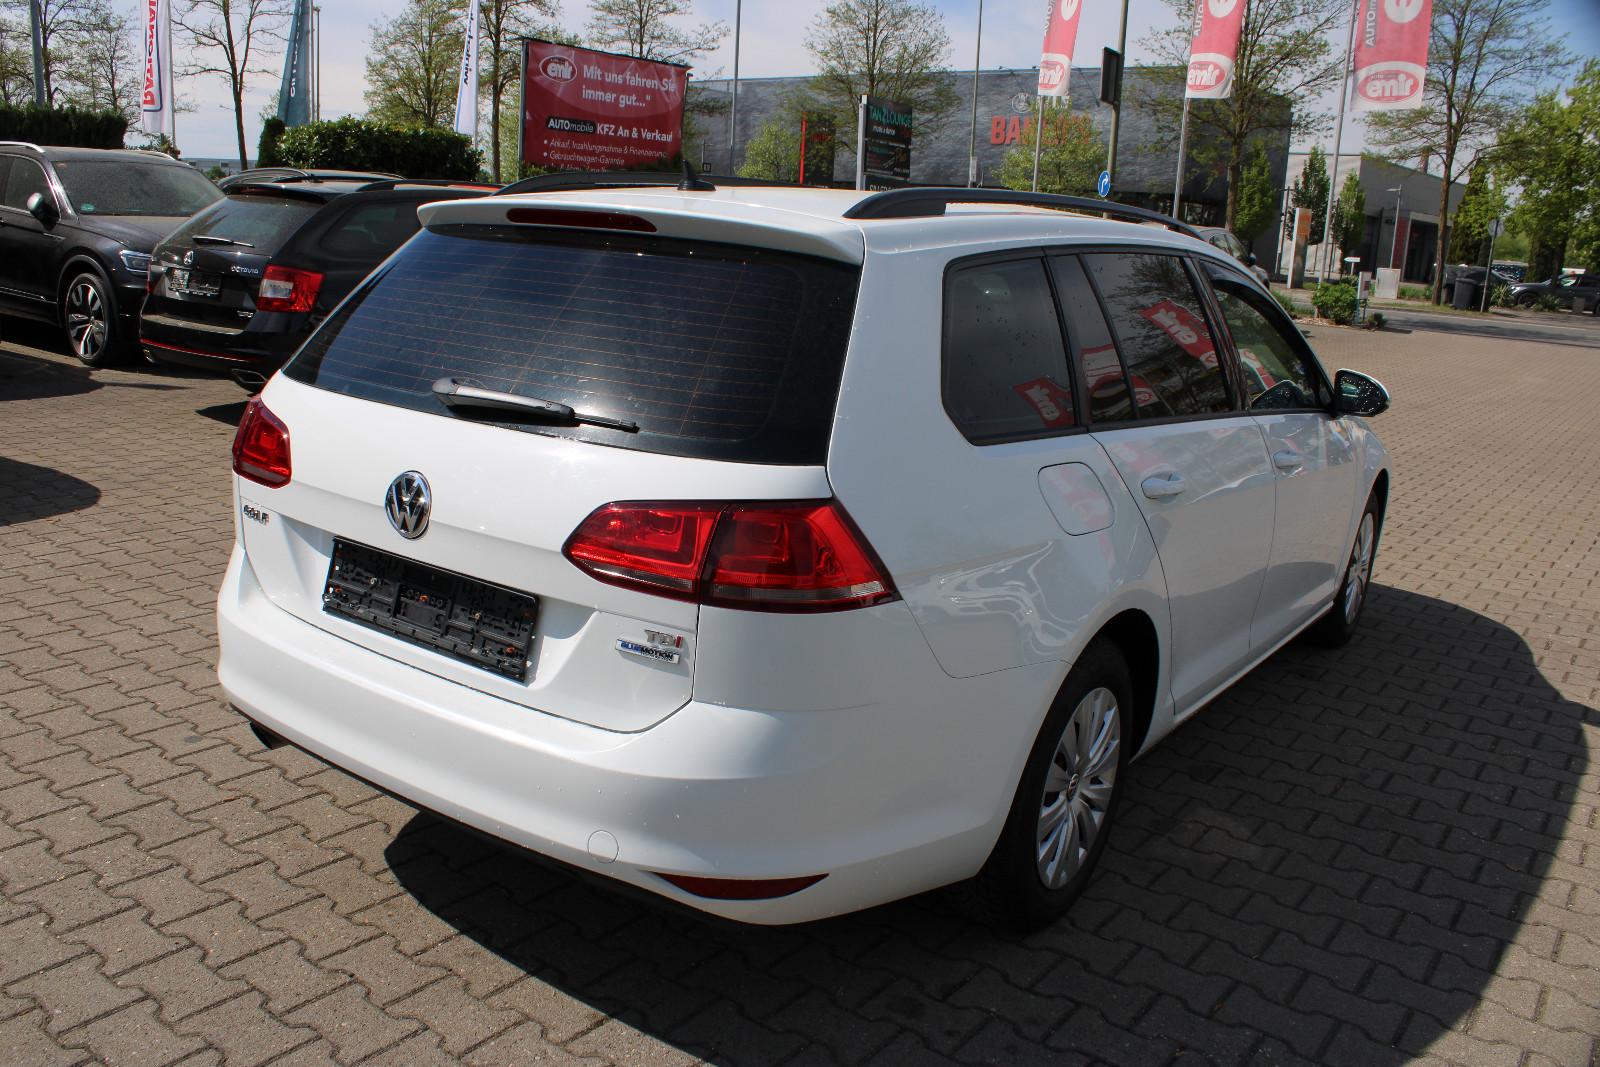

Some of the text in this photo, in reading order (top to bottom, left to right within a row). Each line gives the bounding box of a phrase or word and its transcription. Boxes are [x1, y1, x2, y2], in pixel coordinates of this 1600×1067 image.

[583, 65, 602, 80] Mit
[604, 71, 624, 84] uns
[626, 72, 659, 89] fahren
[1366, 73, 1414, 97] emir
[582, 86, 617, 102] immer
[596, 123, 616, 136] KFZ
[617, 126, 629, 137] An
[631, 127, 639, 138] &
